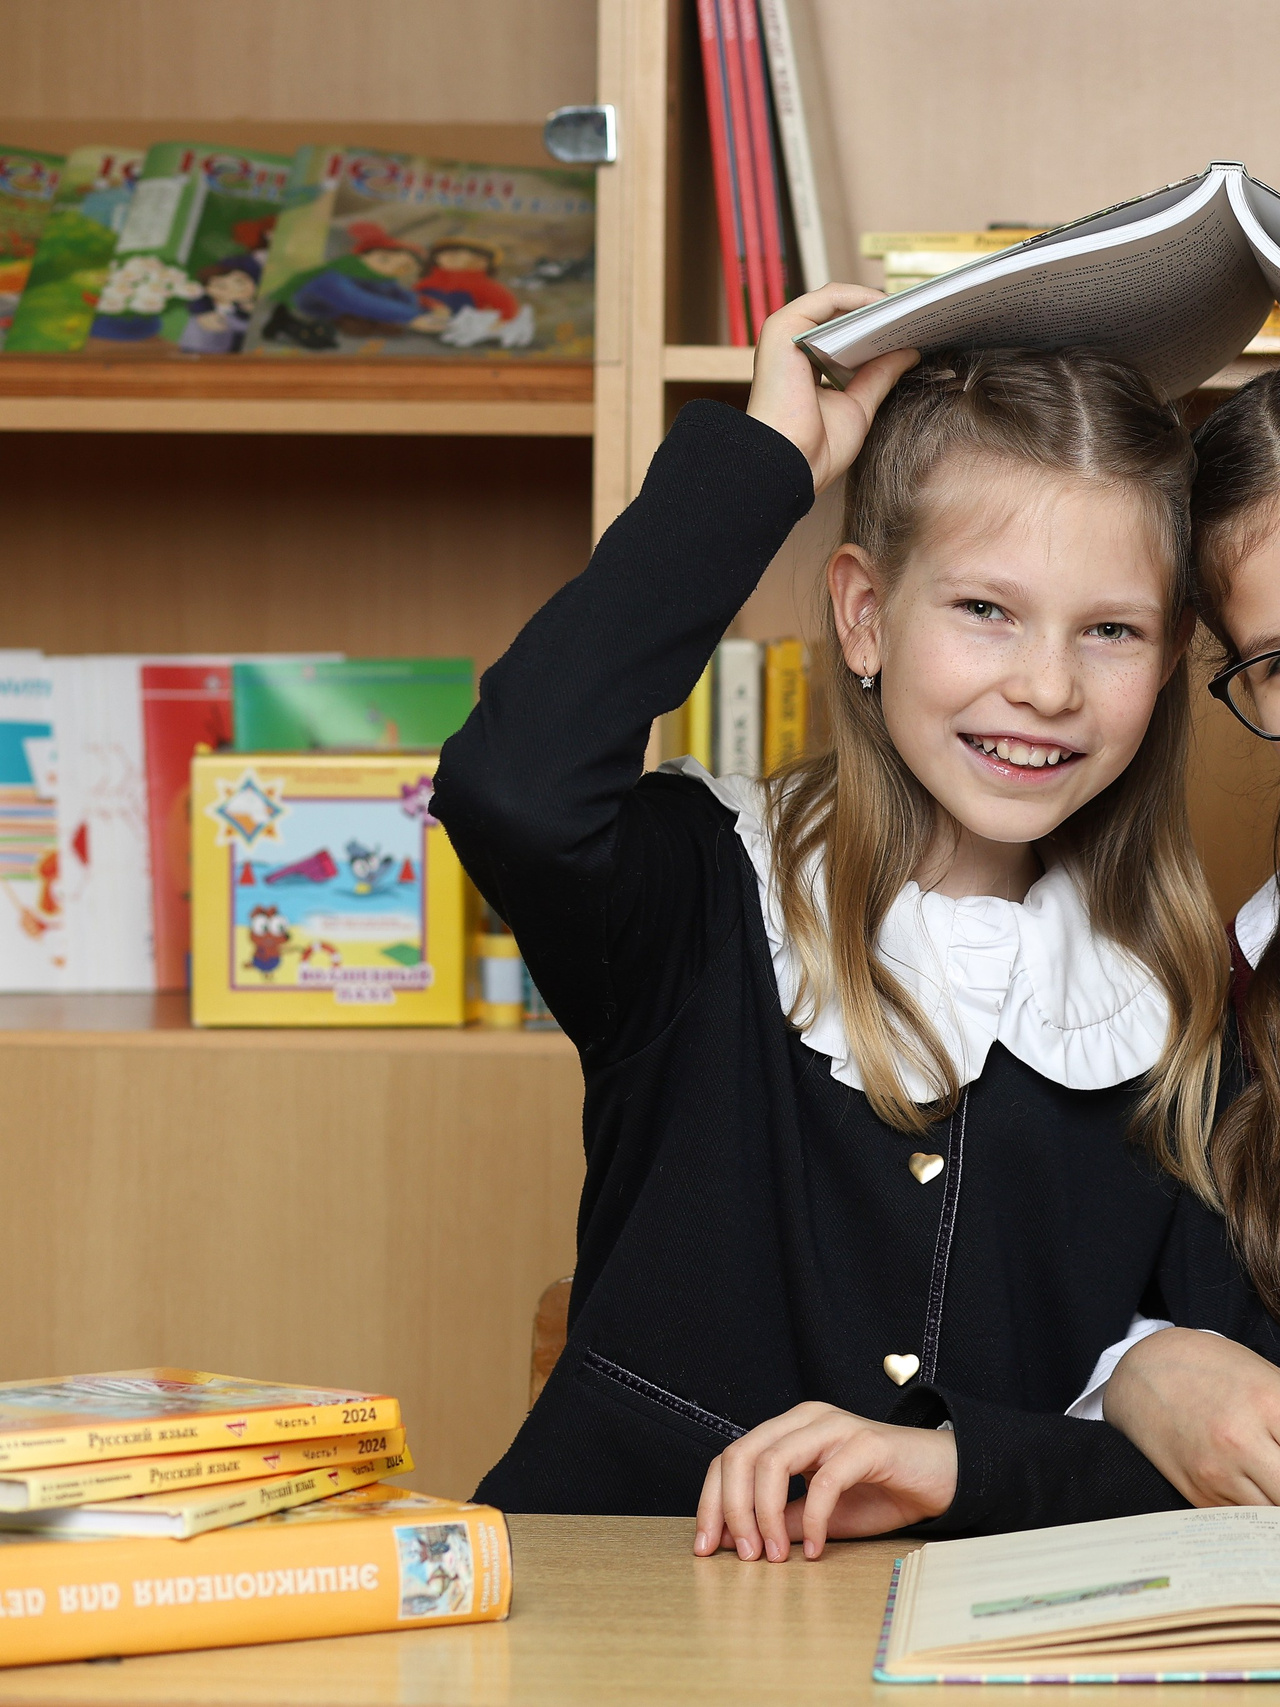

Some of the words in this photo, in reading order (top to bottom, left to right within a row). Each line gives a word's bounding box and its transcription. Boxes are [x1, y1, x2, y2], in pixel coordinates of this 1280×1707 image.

[88, 1427, 153, 1452] Русский
[158, 1426, 199, 1442] язык
[275, 1418, 310, 1429] Часть
[342, 1407, 378, 1424] 2024
[149, 1462, 203, 1487] Русский
[207, 1460, 241, 1475] язык
[302, 1448, 332, 1460] Часть
[358, 1437, 388, 1455] 2024
[386, 1454, 404, 1470] 2024
[58, 1582, 121, 1614] ДЛЯ
[133, 1563, 380, 1608] ЭНЦИКЛОПЕДИЯ
